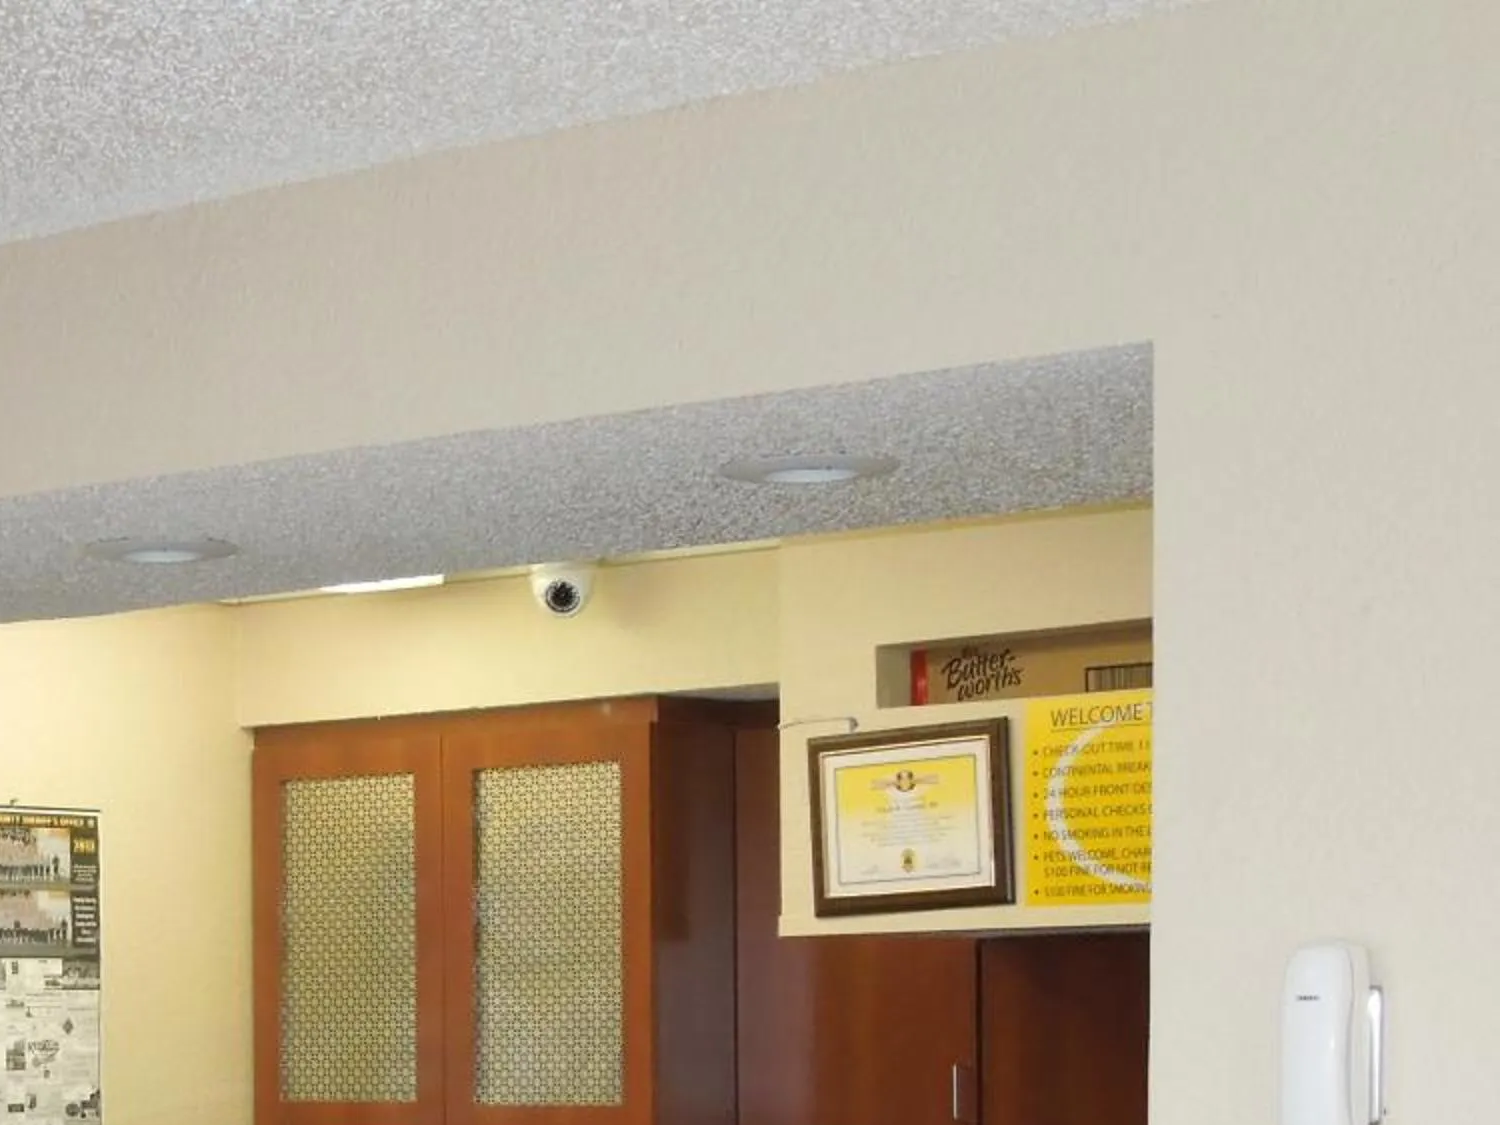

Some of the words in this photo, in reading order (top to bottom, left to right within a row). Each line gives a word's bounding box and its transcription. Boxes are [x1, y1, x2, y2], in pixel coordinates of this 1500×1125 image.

[1050, 704, 1142, 727] WELCOME
[1043, 763, 1112, 778] CONTINENTAL
[1093, 783, 1129, 795] FRONT
[1043, 807, 1098, 820] PERSONAL
